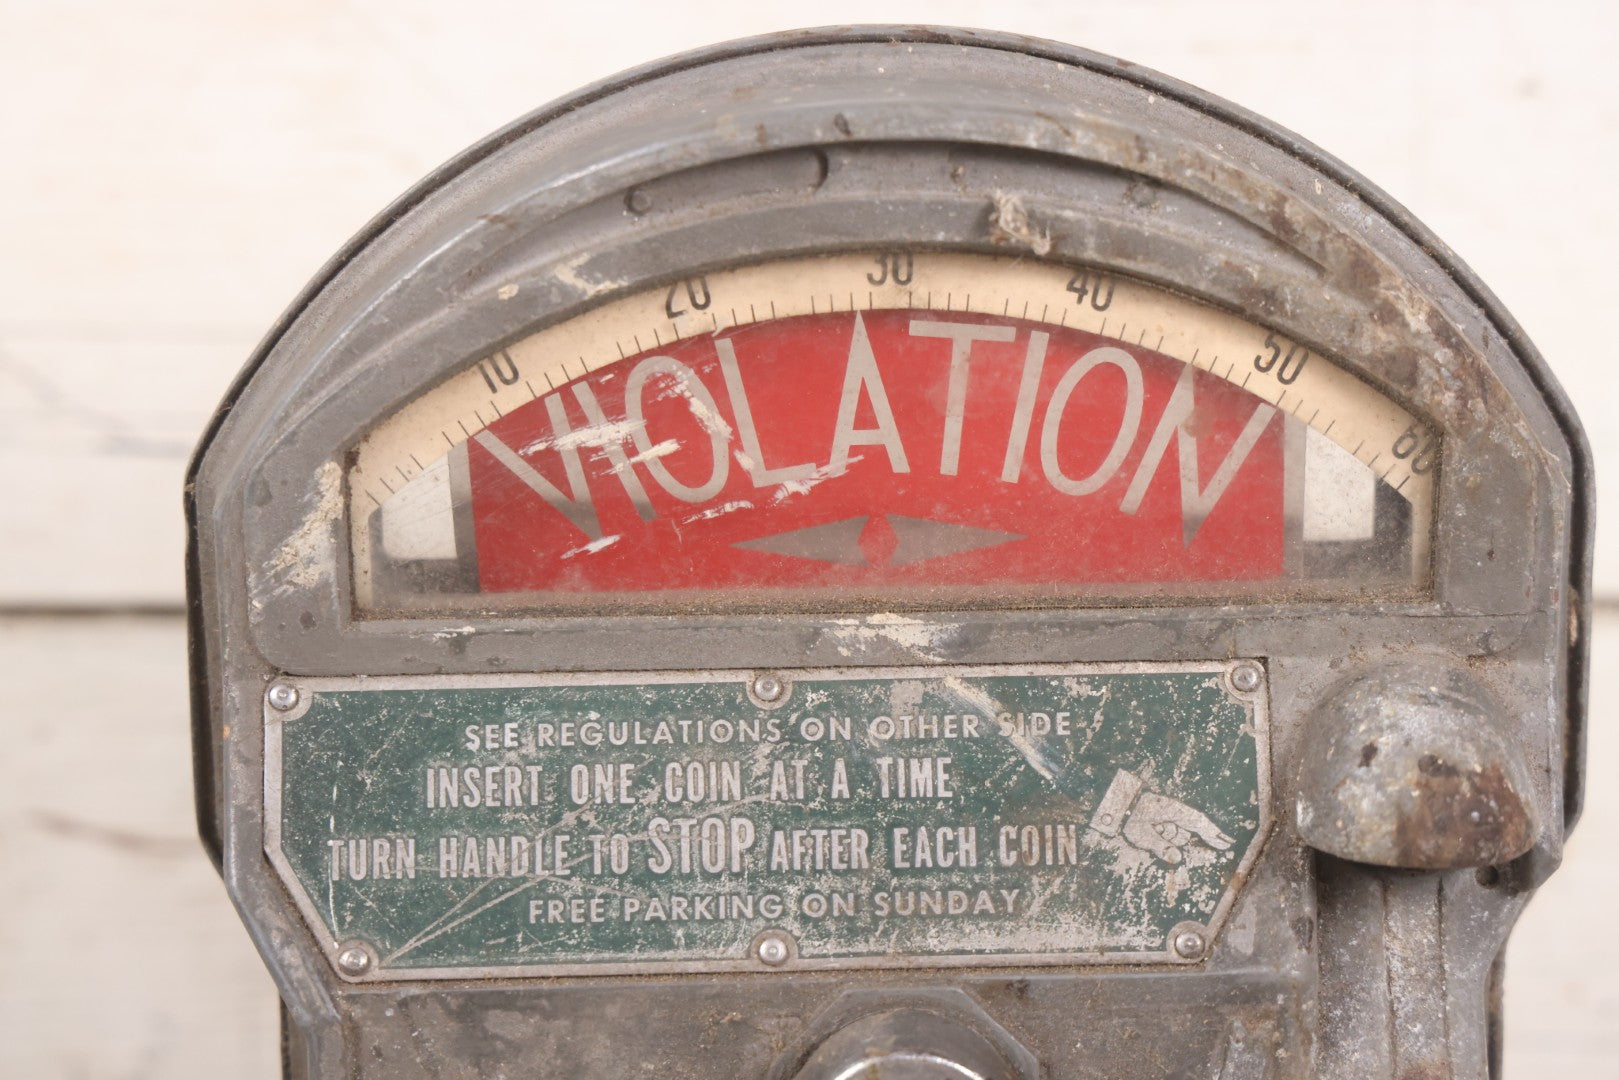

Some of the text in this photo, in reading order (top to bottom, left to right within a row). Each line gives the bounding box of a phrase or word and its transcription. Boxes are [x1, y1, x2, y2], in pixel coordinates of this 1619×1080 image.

[477, 254, 1435, 476] 10 20 30 40 50 60
[473, 310, 1278, 549] VIOLATION
[465, 711, 1072, 750] SEE REGULATIONS ON OTHER SIDE
[426, 756, 954, 809] INSERT ONE COIN AT A TIME
[329, 816, 1077, 882] TURN HANDLE TO STOP AFTER EACH COIN
[529, 889, 1021, 924] FREE PARKING ON SUNDAY
